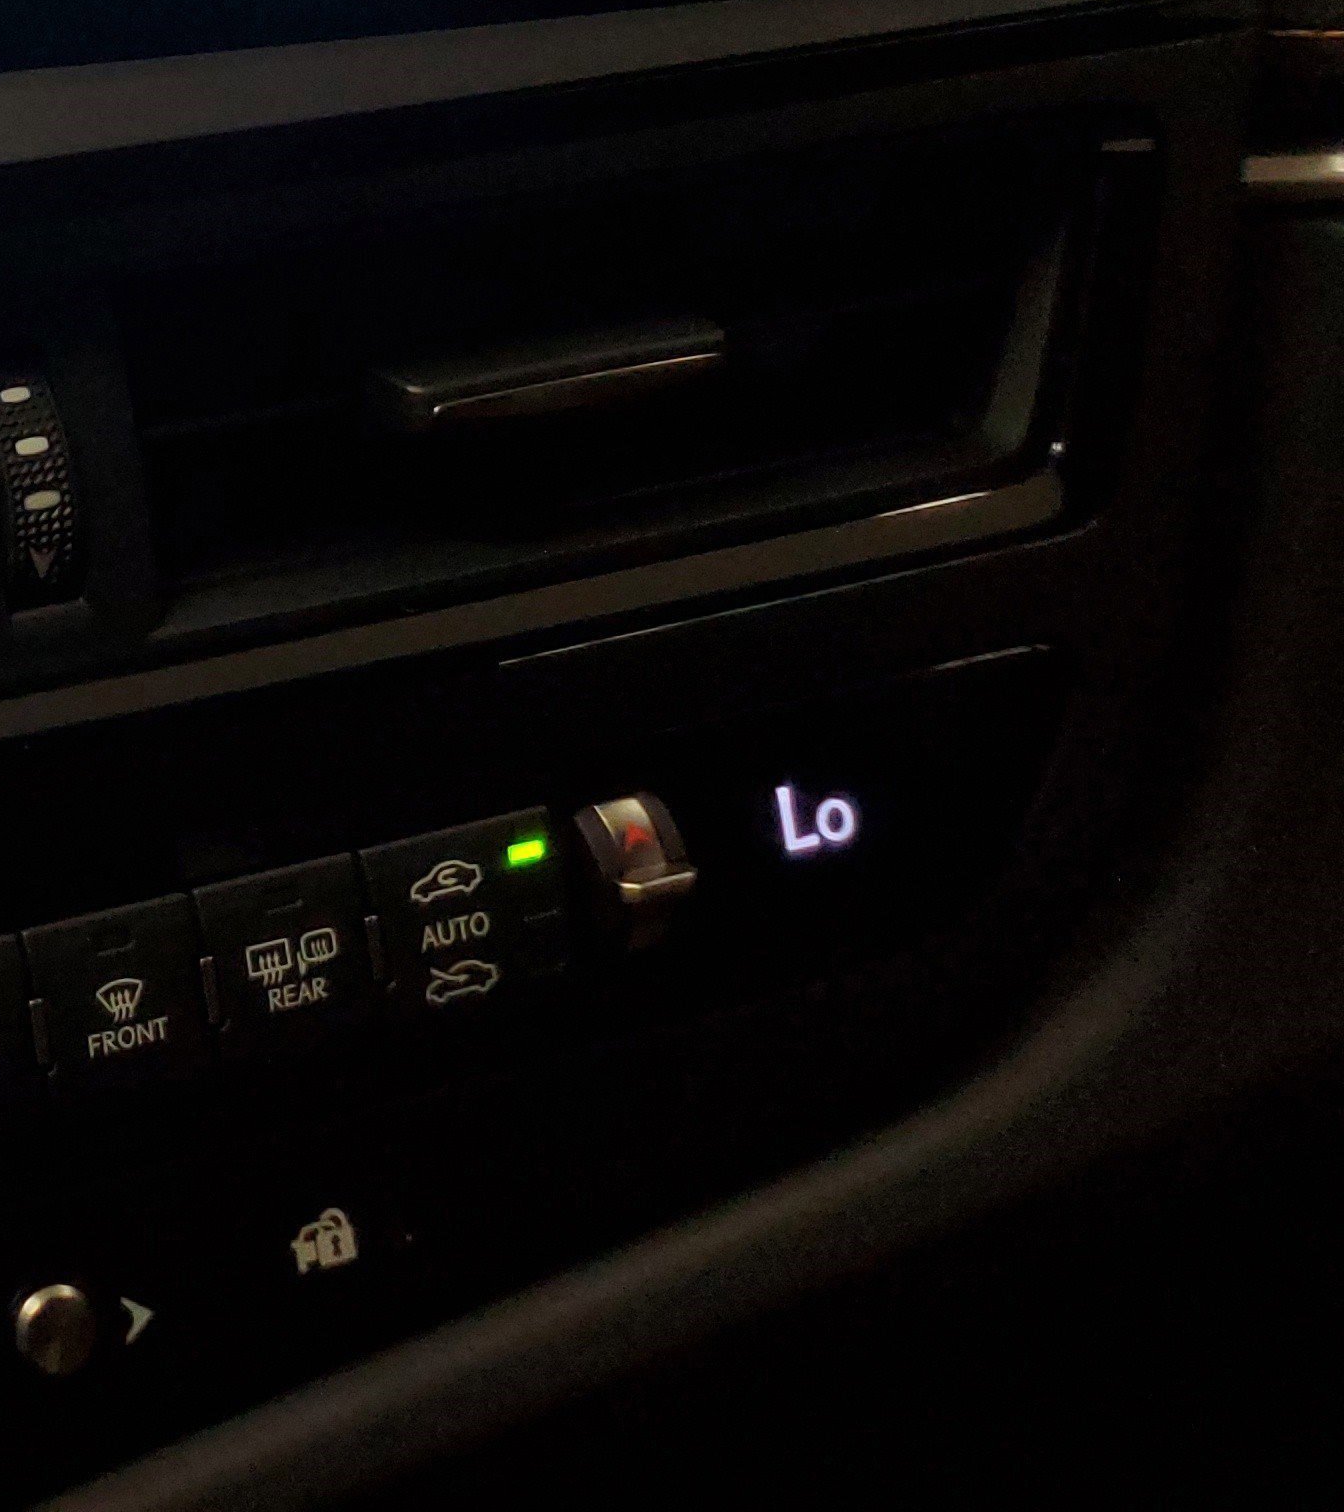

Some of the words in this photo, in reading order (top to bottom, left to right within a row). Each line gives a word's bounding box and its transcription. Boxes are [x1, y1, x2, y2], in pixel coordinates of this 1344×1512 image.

[776, 786, 858, 851] Lo
[421, 911, 491, 953] AUTO
[268, 976, 330, 1012] REAR
[87, 1015, 169, 1059] FRONT
